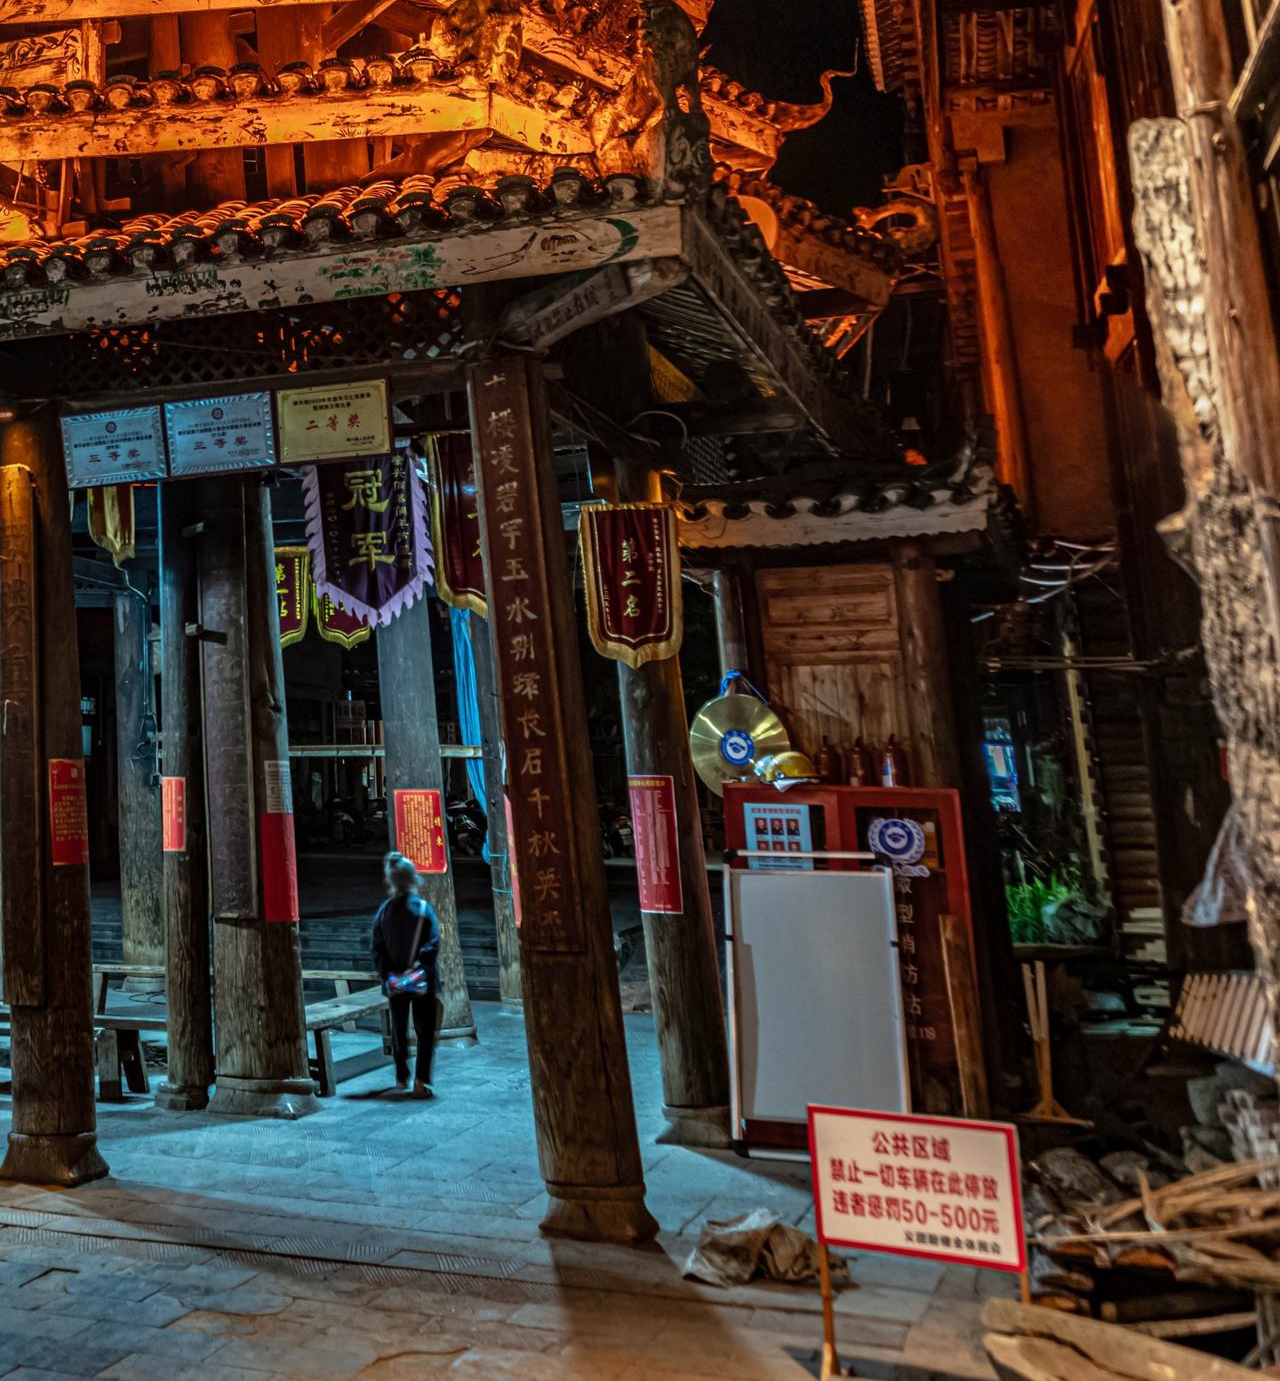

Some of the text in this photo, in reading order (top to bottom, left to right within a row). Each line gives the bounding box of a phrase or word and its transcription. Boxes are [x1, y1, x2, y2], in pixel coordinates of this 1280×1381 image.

[305, 413, 361, 432] 二等奖
[89, 449, 141, 463] 三等奖
[193, 435, 249, 450] 三等奖
[342, 469, 396, 571] 冠军
[621, 538, 642, 617] 第二名
[872, 1130, 951, 1163] 公共区域
[830, 1157, 1000, 1202] 禁止一切车辆在此停放
[832, 1189, 1001, 1235] 违者惩罚50-500元
